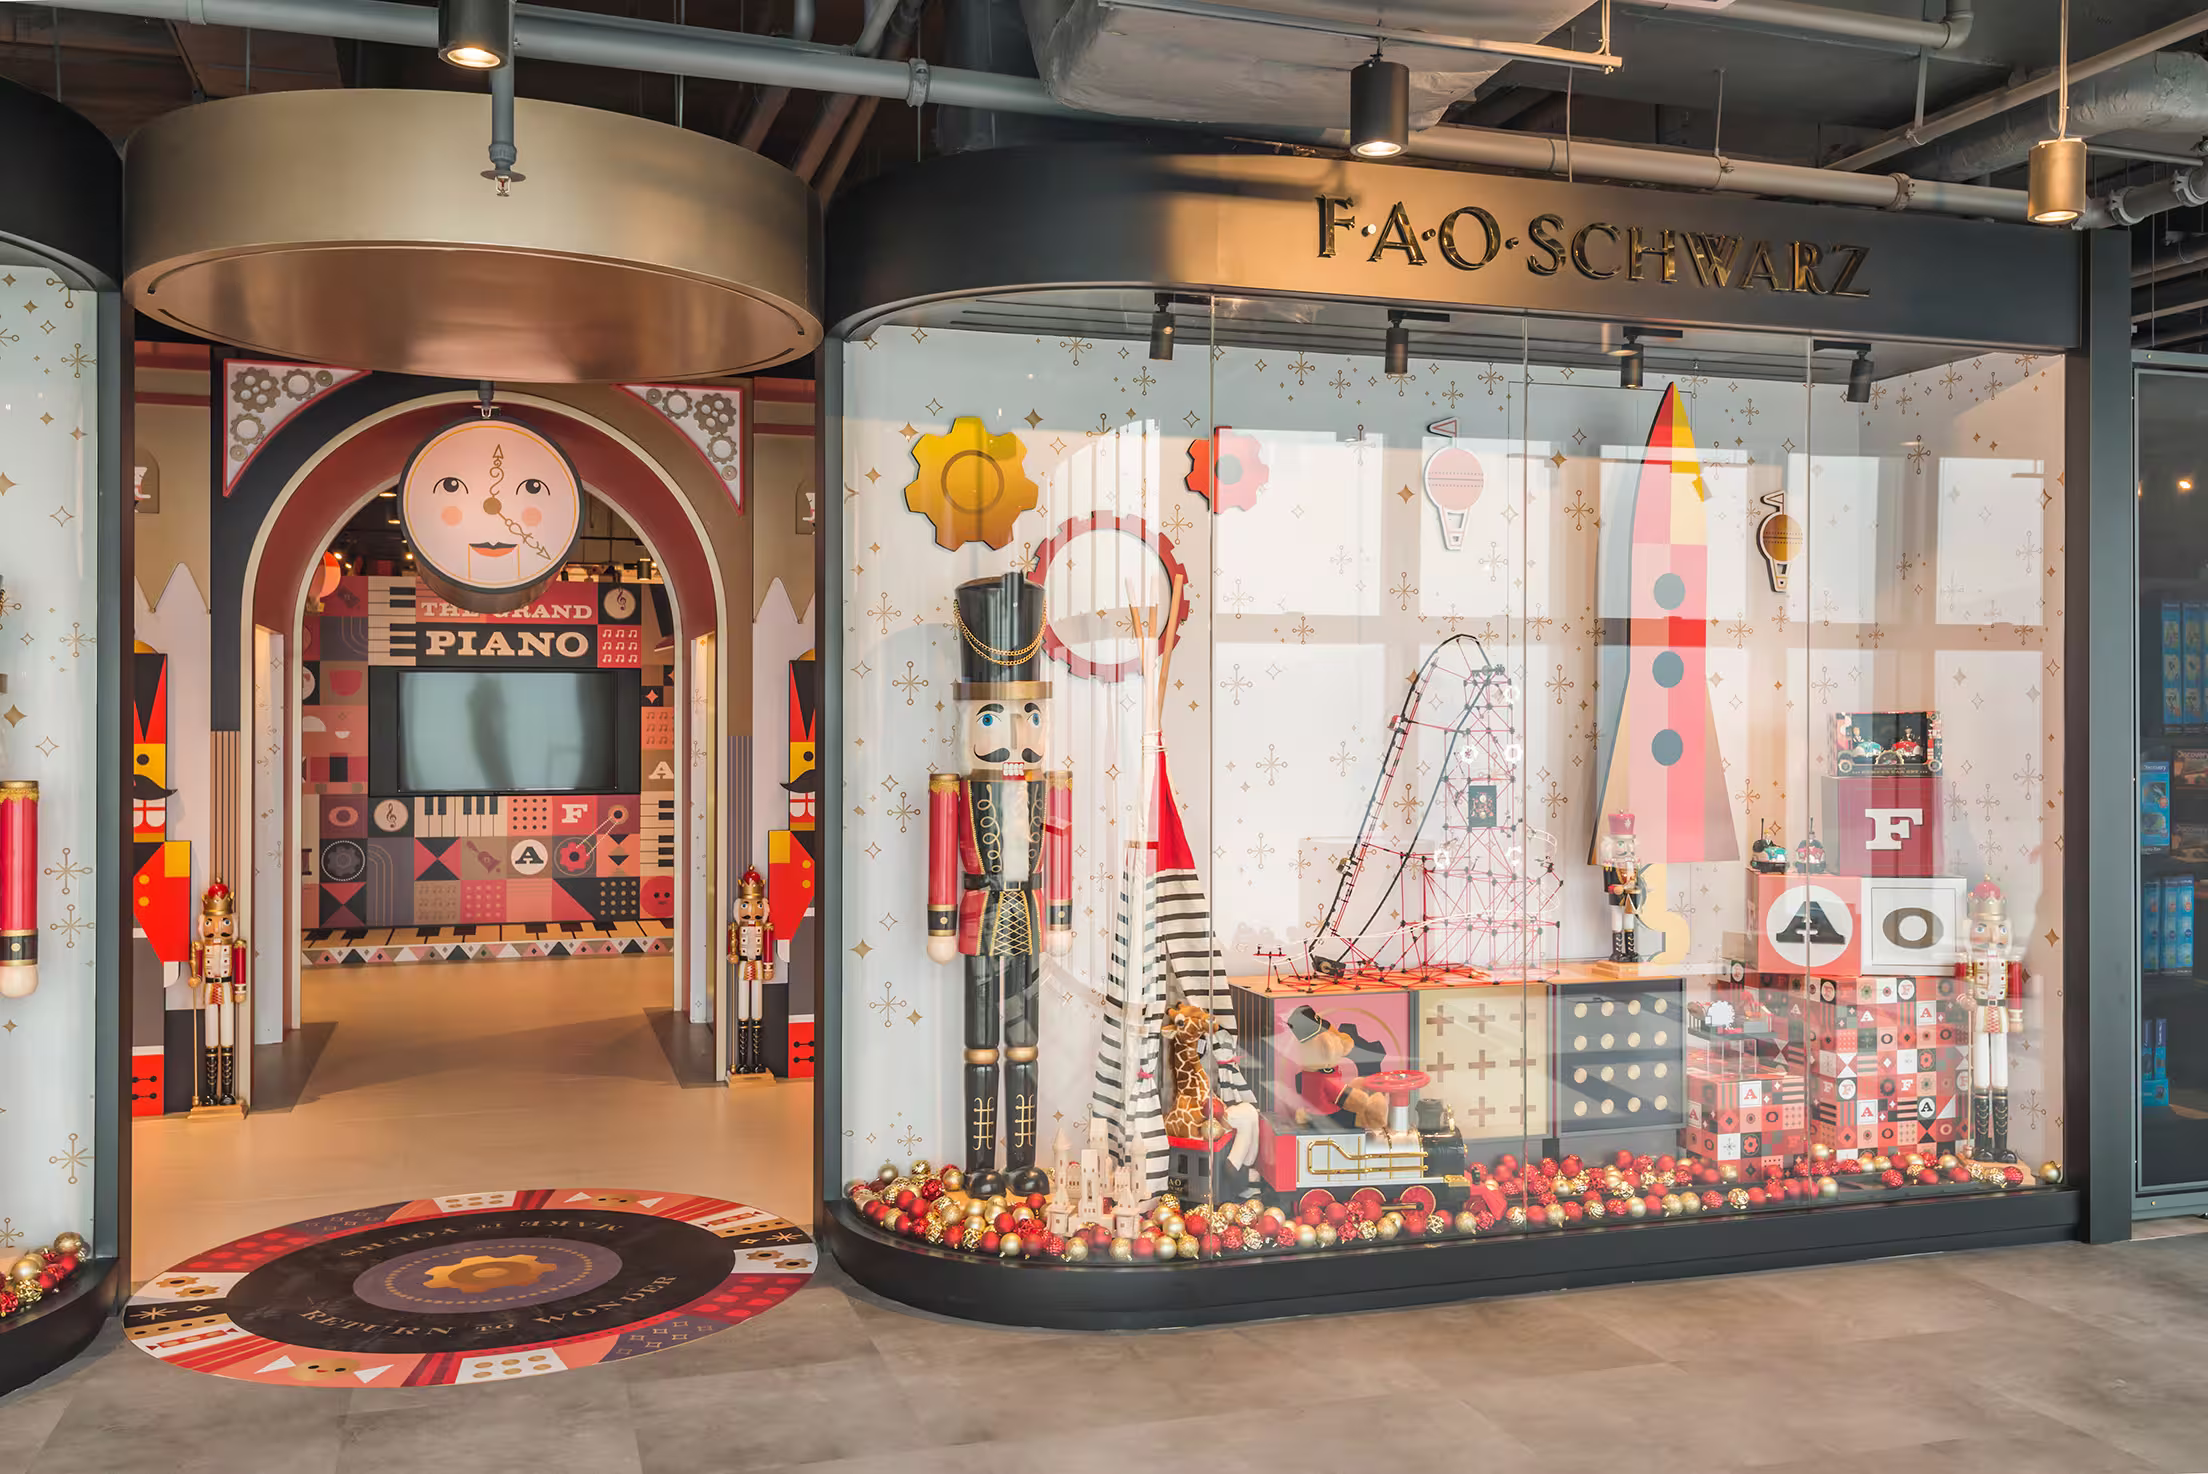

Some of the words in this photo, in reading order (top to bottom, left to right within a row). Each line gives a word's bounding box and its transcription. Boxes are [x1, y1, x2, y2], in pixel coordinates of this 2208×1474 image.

[425, 630, 589, 657] PIANO
[648, 760, 674, 780] A
[561, 803, 588, 823] F
[1865, 808, 1923, 850] F
[515, 846, 544, 865] A
[1776, 901, 1845, 944] A
[1882, 907, 1944, 949] O
[1860, 1010, 1874, 1022] A
[1920, 1008, 1932, 1018] A
[1744, 1089, 1757, 1100] A
[1901, 1079, 1913, 1091] F
[1689, 1109, 1698, 1120] A
[1861, 1107, 1873, 1117] A
[1921, 1102, 1933, 1112] A
[299, 1309, 455, 1336] RETURN
[475, 1323, 518, 1333] TO
[533, 1273, 680, 1325] WONDER
